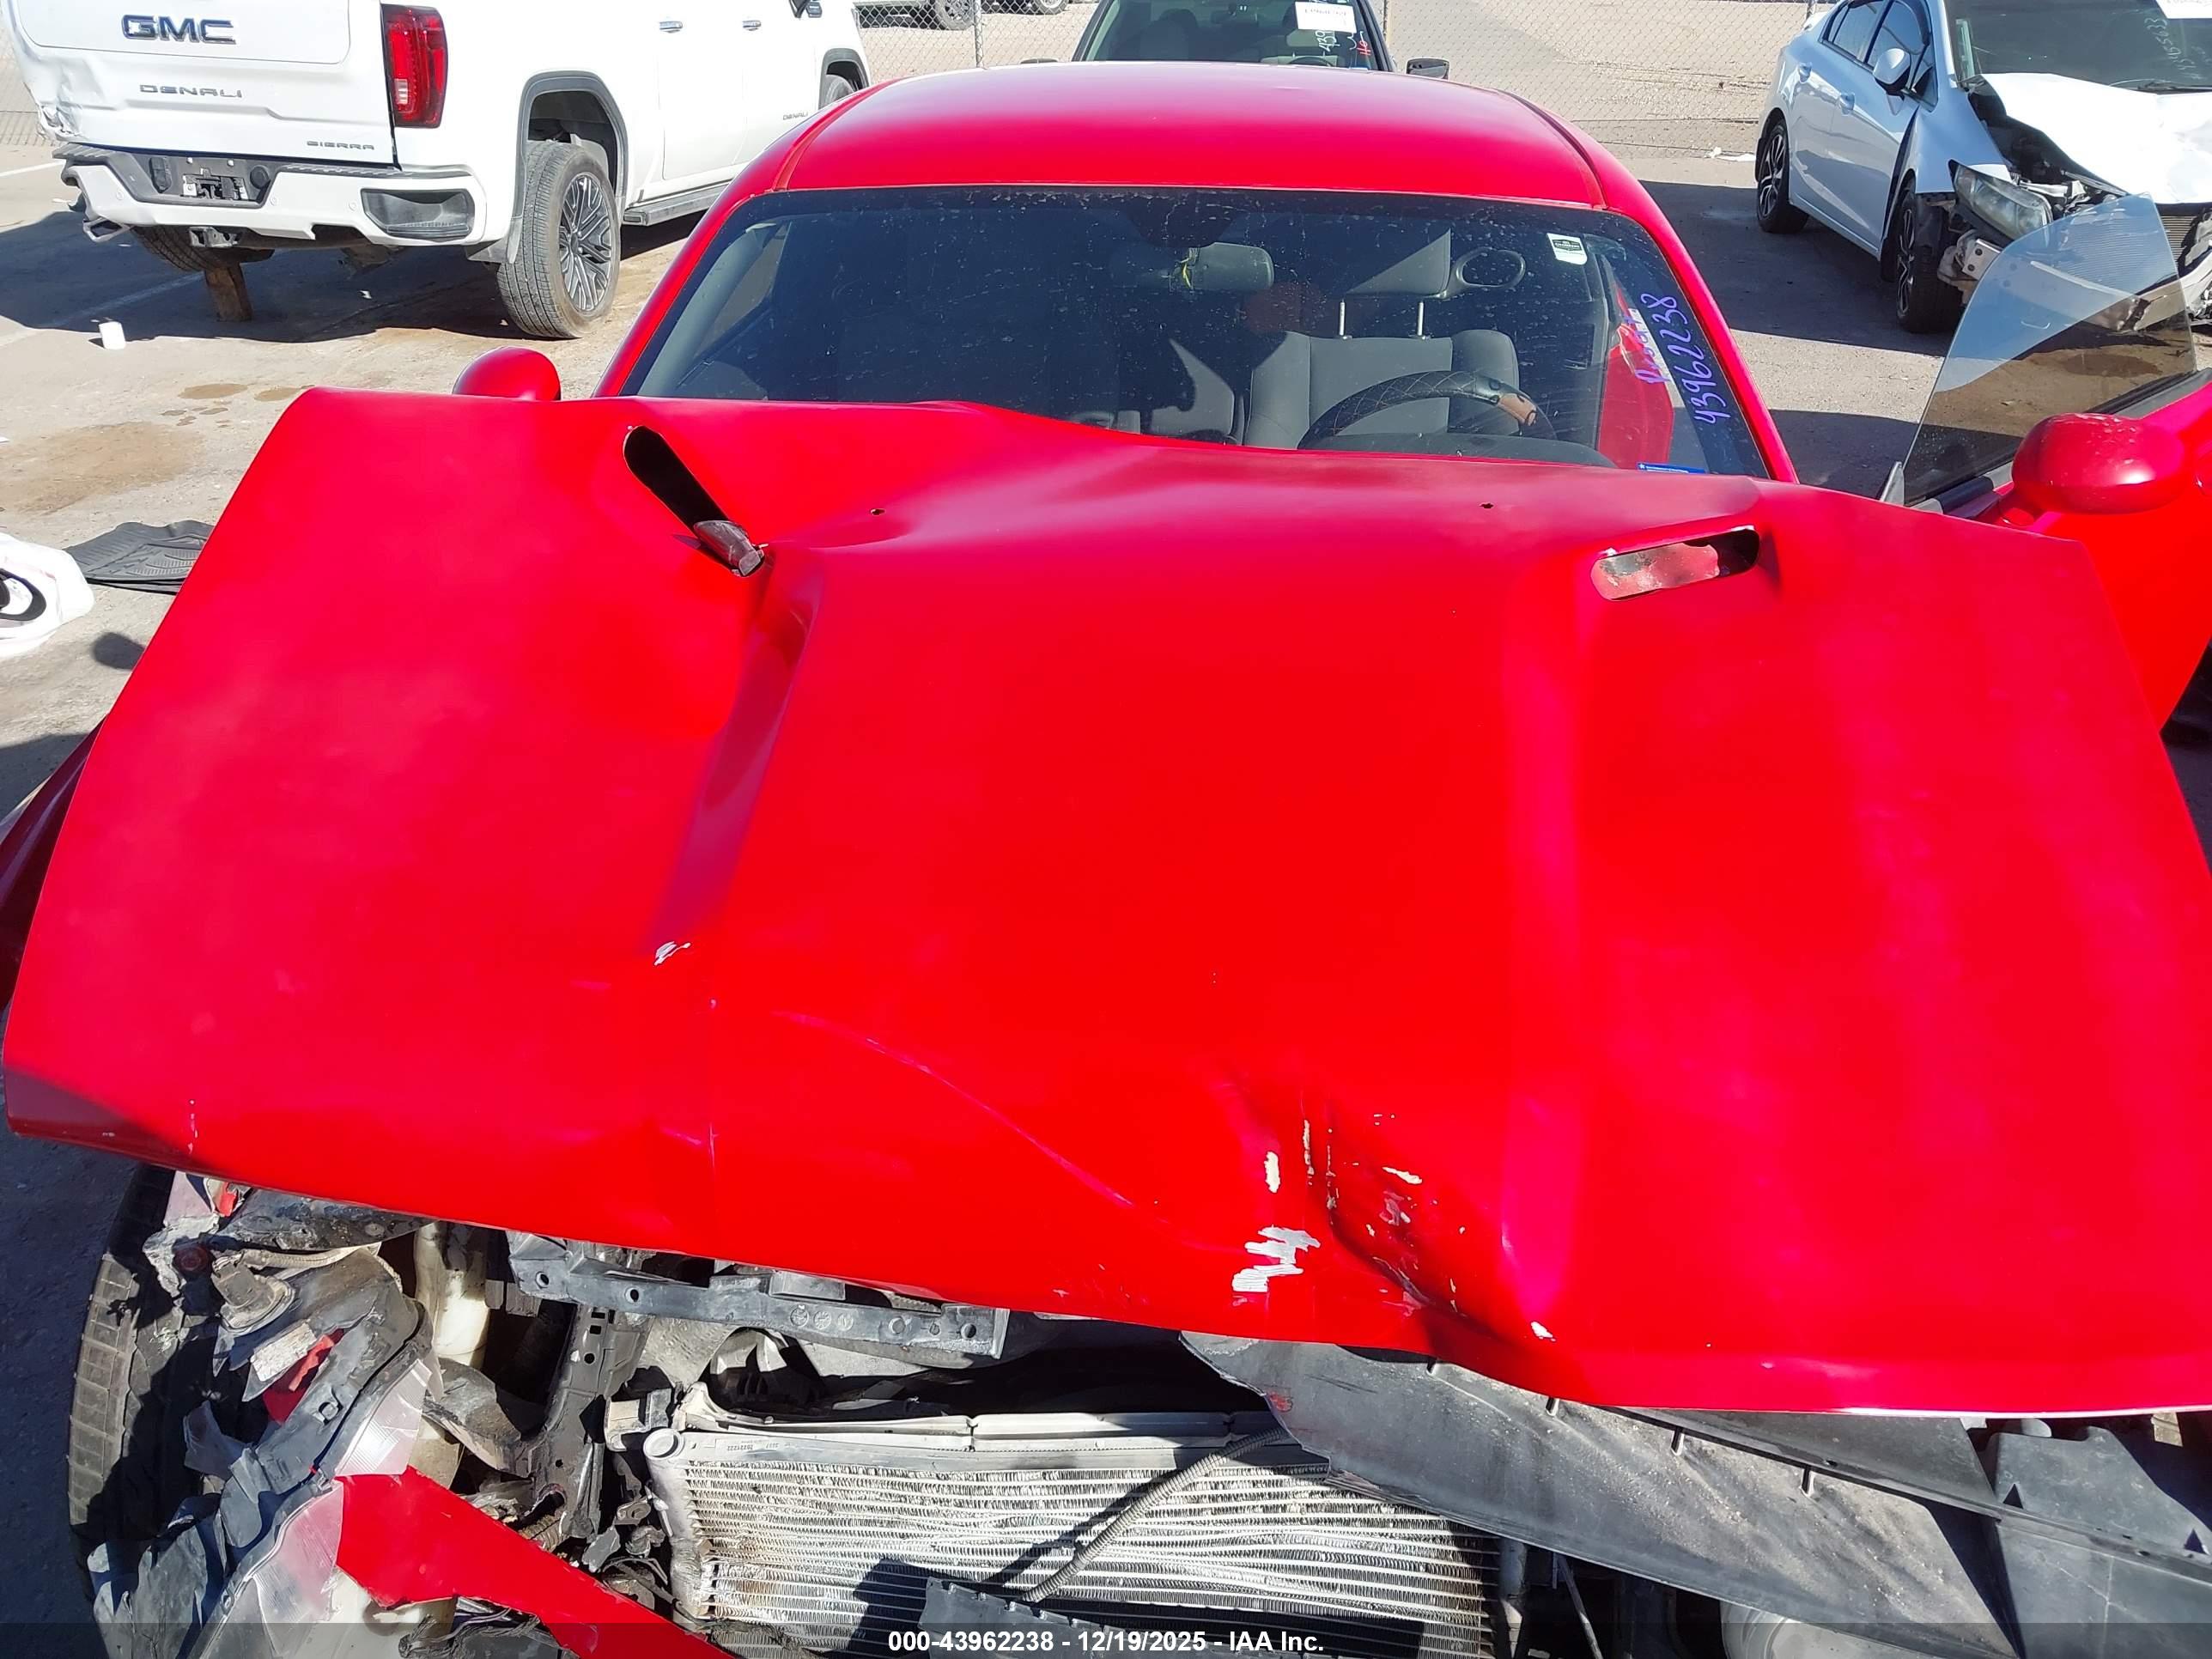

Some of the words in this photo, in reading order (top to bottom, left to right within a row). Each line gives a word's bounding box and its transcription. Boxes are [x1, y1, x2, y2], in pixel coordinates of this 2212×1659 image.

[122, 15, 236, 45] GMC
[139, 84, 242, 98] DENALI
[307, 141, 374, 150] SIERRA
[1640, 294, 1731, 423] 43962238
